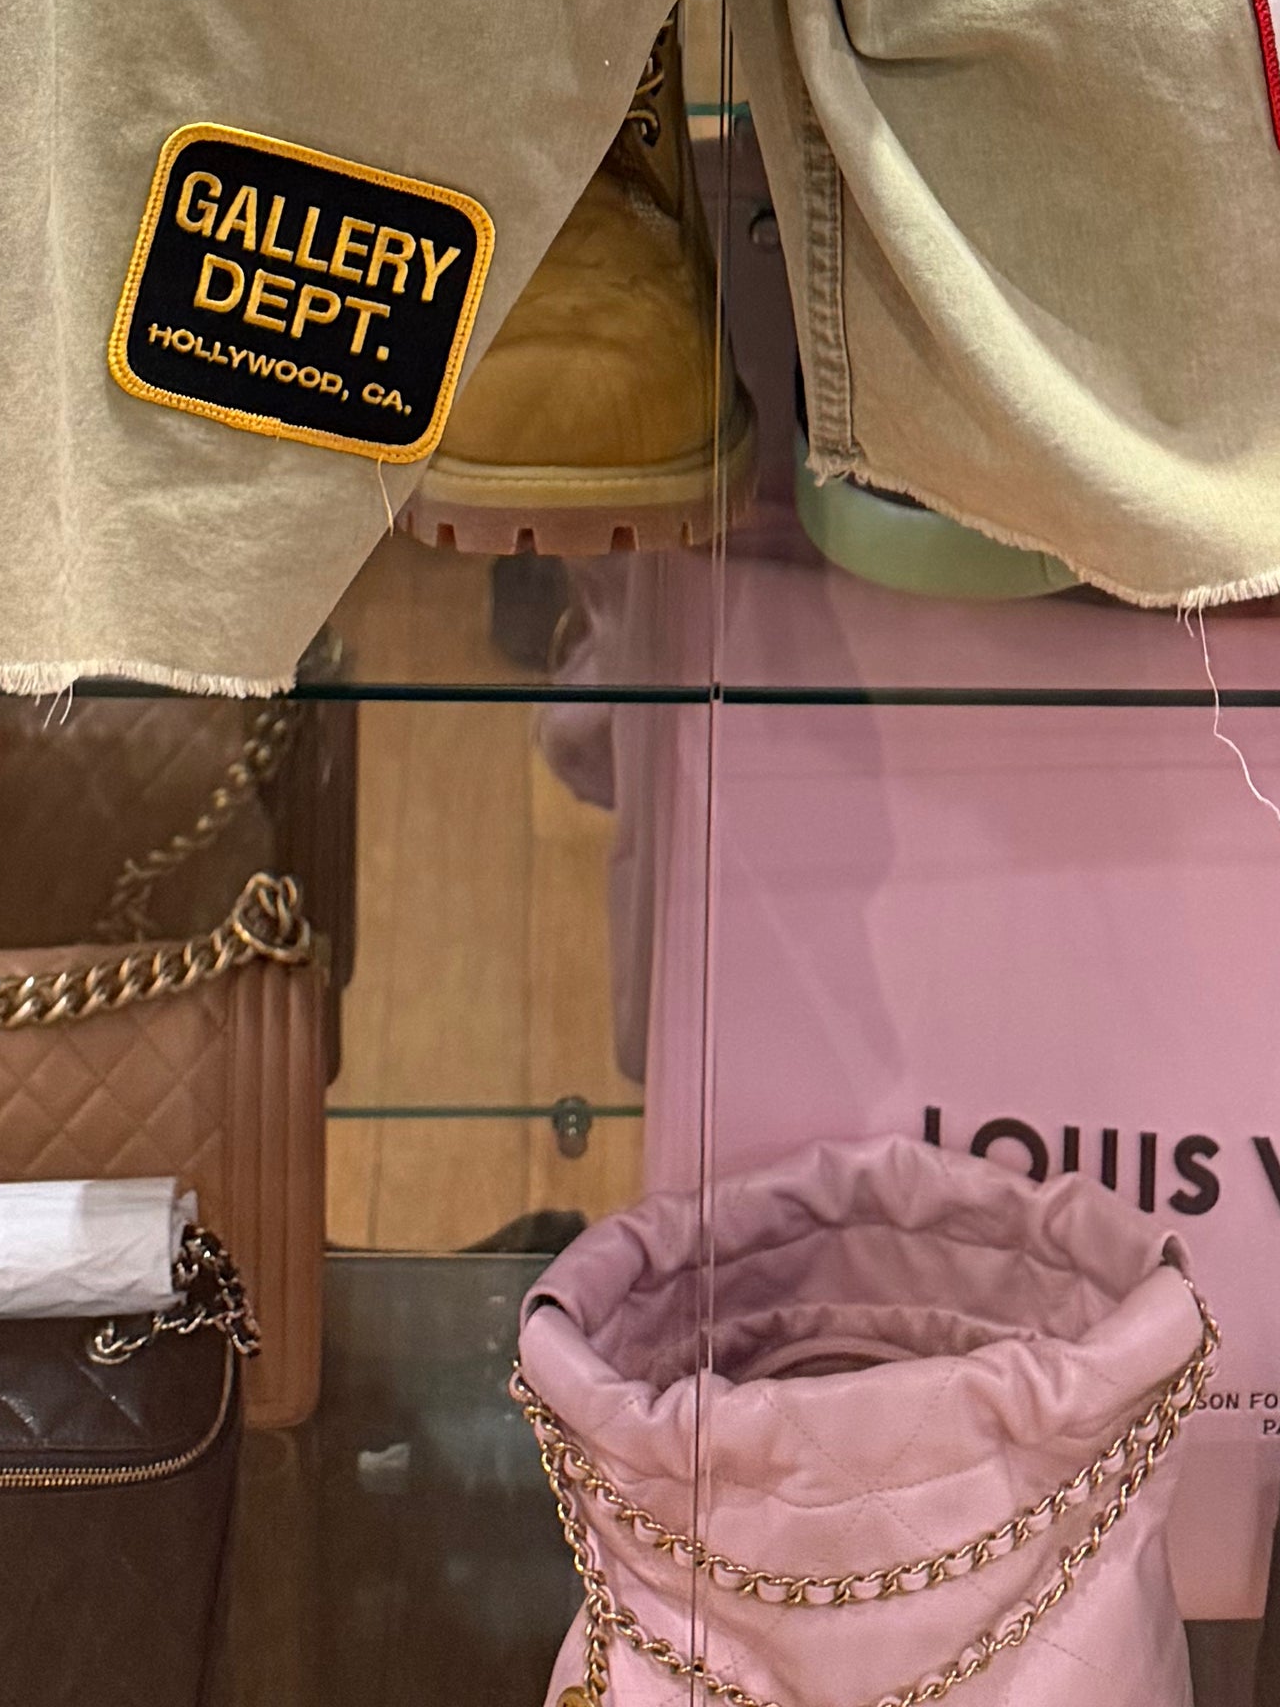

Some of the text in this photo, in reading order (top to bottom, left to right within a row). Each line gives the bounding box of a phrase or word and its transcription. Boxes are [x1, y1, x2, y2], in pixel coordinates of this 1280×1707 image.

[174, 170, 462, 302] GALLERY
[148, 322, 350, 402] HOLLYWOOD,
[192, 252, 392, 362] DEPT.
